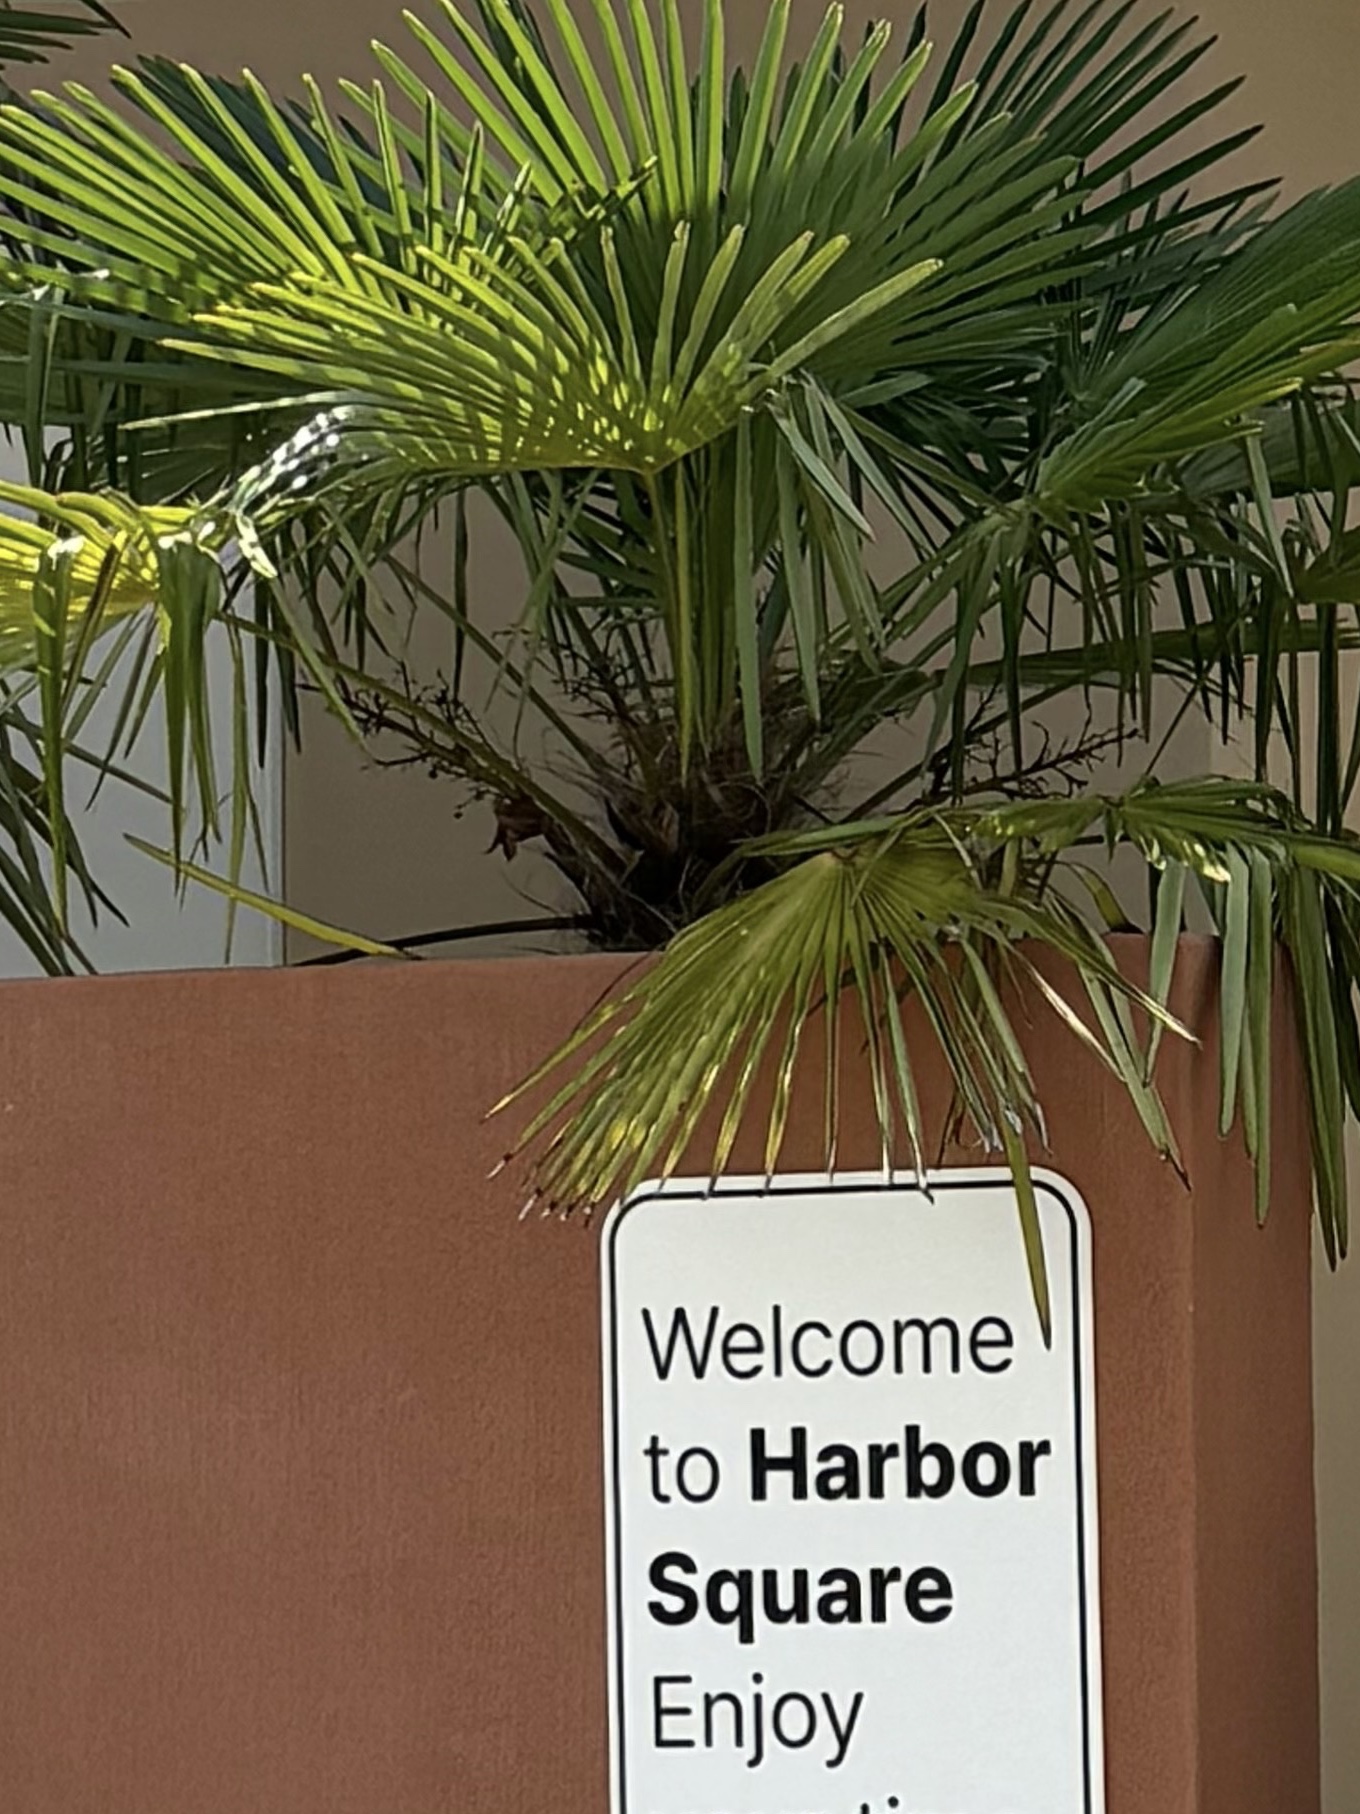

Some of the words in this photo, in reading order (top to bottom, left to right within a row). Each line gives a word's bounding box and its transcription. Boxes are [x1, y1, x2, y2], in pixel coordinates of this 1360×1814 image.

[642, 1305, 1013, 1380] Welcome
[644, 1435, 719, 1503] to
[750, 1425, 1051, 1501] Harbor
[648, 1552, 952, 1644] Square
[654, 1673, 863, 1768] Enjoy
